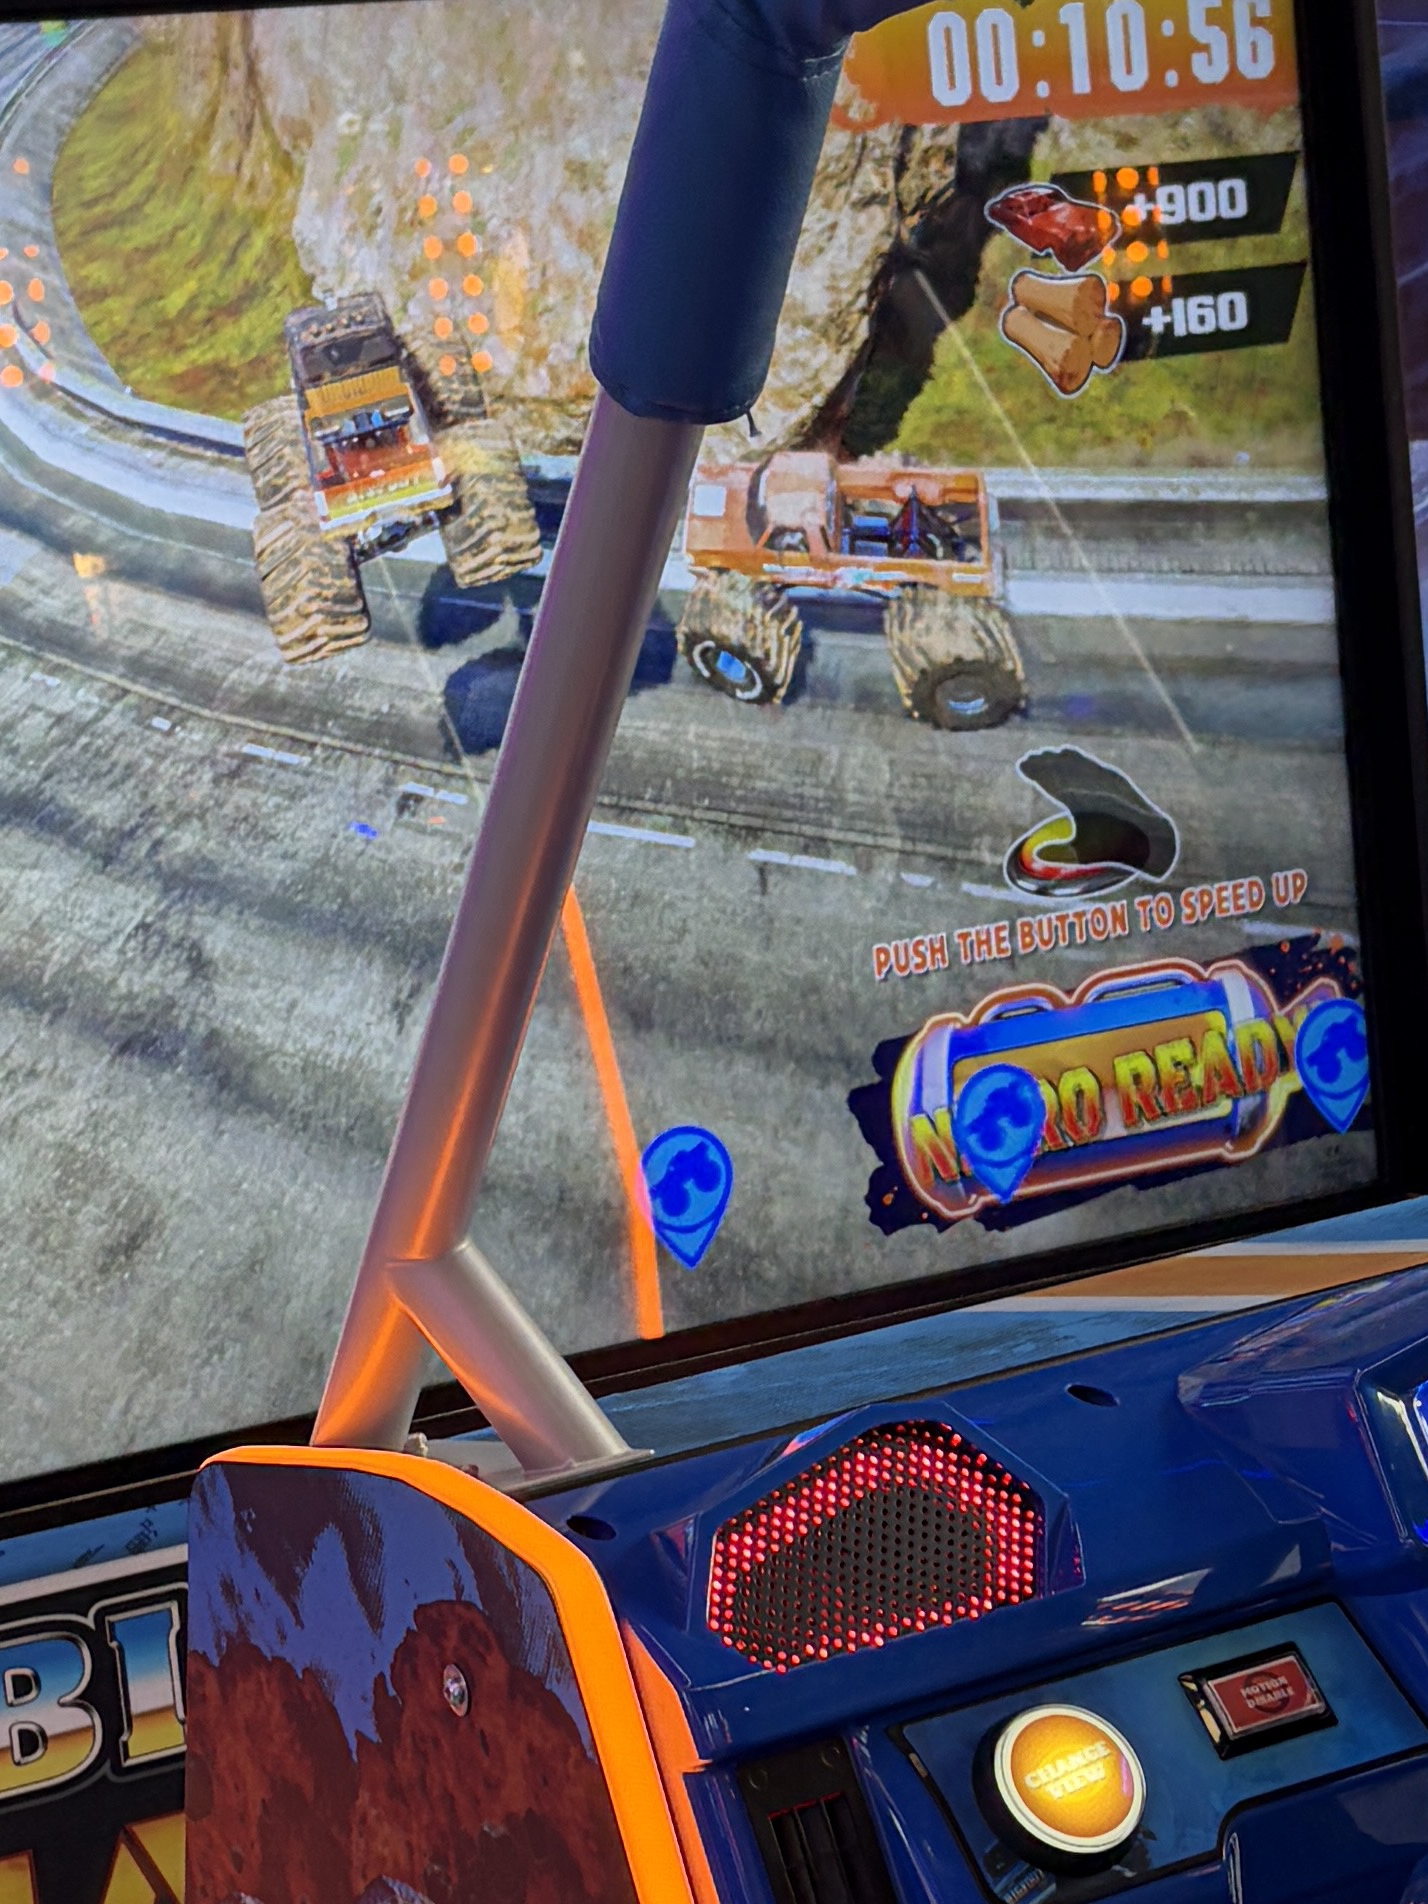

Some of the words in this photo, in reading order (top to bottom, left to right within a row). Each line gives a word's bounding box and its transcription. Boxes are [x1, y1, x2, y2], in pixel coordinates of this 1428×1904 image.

[1141, 291, 1249, 338] +160
[873, 928, 949, 983] PUSH
[956, 920, 1012, 966] THE
[1017, 899, 1130, 956] BUTTON
[1135, 891, 1176, 933] TO
[1180, 876, 1267, 926] SPEED
[1272, 868, 1309, 907] UP
[910, 1066, 1103, 1188] NRO
[1239, 1674, 1290, 1698] MOTION
[1245, 1685, 1296, 1710] DISABLE
[1023, 1739, 1113, 1792] CHANGE
[1043, 1762, 1108, 1801] VIEW
